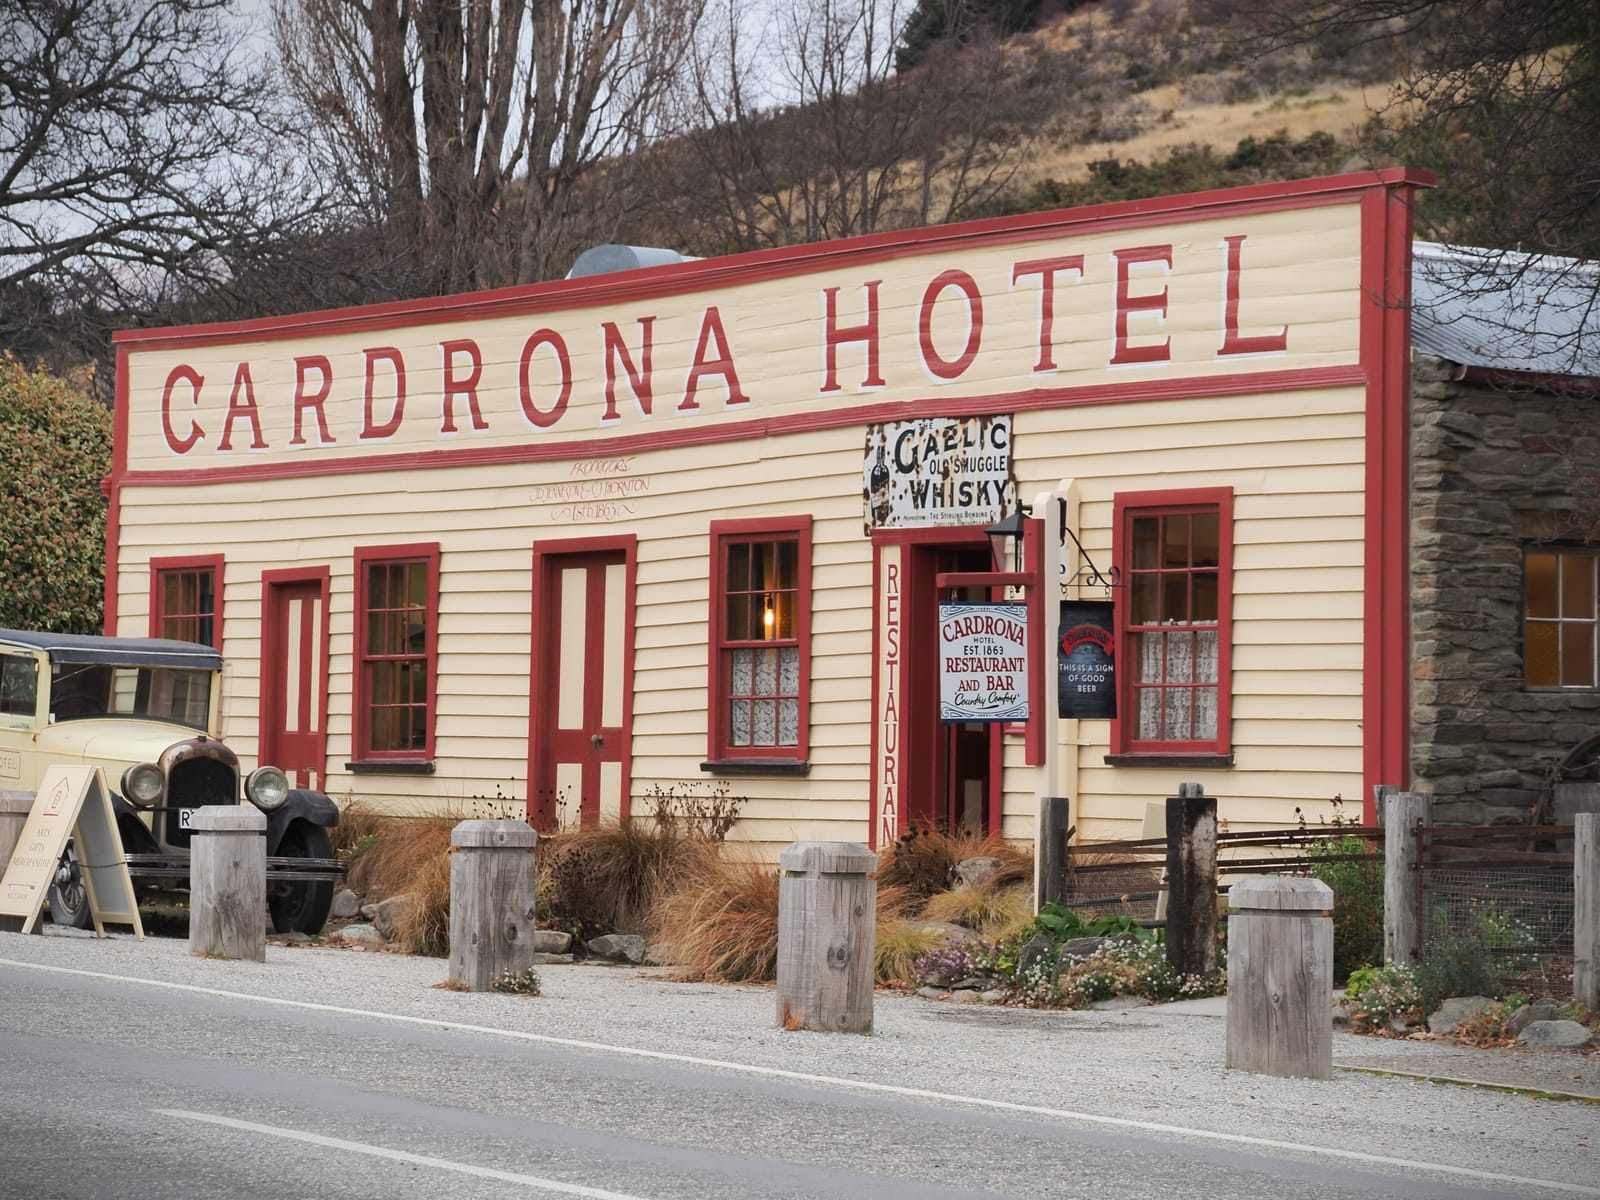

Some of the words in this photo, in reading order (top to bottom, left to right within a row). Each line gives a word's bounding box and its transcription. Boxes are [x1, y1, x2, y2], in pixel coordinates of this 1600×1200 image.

[160, 305, 751, 455] CARDRONA
[820, 234, 1290, 393] HOTEL
[894, 422, 1008, 475] GAELIC
[953, 454, 1010, 474] SMUGGLE
[942, 615, 1025, 647] CARDRONA
[983, 646, 1004, 656] 1863
[945, 657, 1025, 673] RESTAURANT
[1059, 664, 1076, 672] THIS
[1078, 664, 1086, 672] IS
[1087, 664, 1094, 672] A
[1095, 664, 1114, 673] SIGN
[958, 679, 981, 692] AND
[986, 675, 1015, 691] BAR
[1068, 674, 1079, 682] OF
[1081, 674, 1105, 683] GOOD
[1077, 684, 1097, 693] BEER
[881, 563, 899, 848] RESTAURAN
